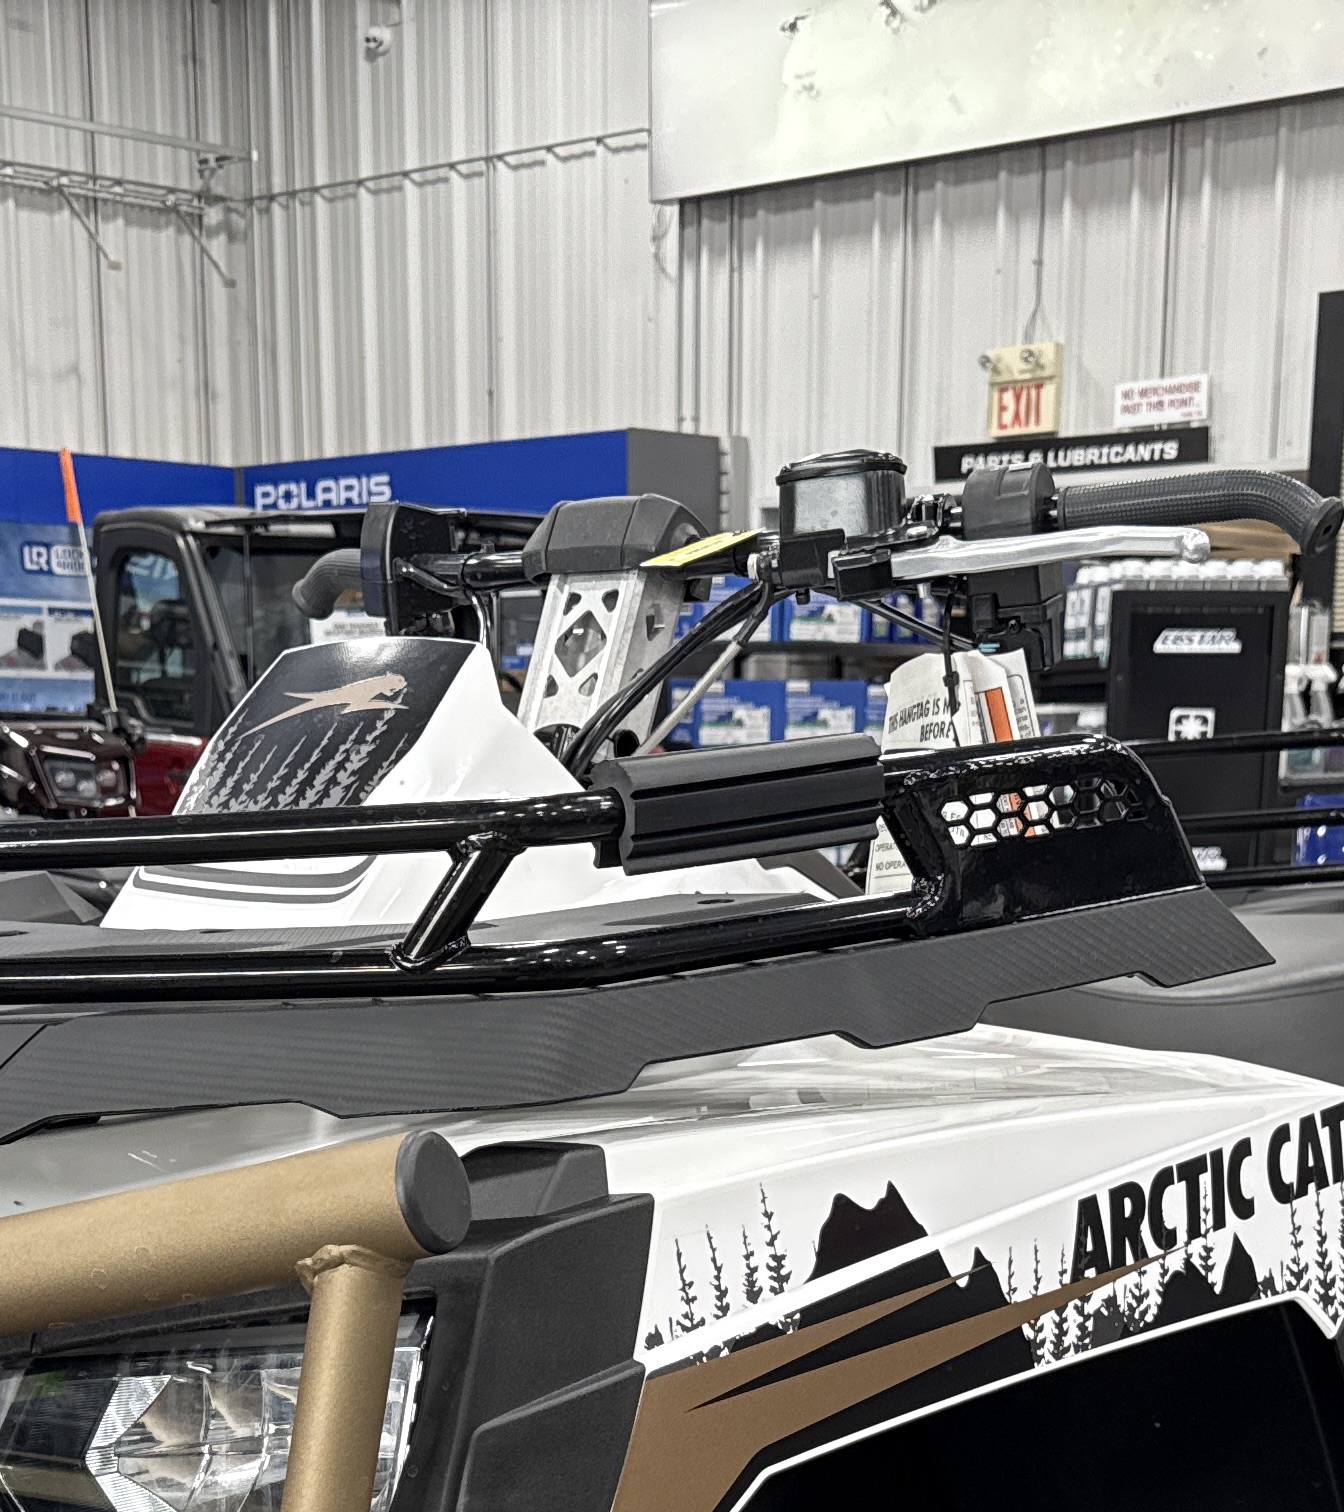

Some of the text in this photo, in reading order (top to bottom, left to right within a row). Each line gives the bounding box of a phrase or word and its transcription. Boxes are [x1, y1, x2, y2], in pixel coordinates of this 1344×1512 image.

[997, 383, 1045, 431] EXIT
[1046, 440, 1180, 468] LUBRICANTS
[253, 474, 393, 511] POLARIS
[899, 699, 930, 728] HANGTAG
[932, 697, 941, 717] IS
[1069, 1136, 1254, 1286] ARCTIC
